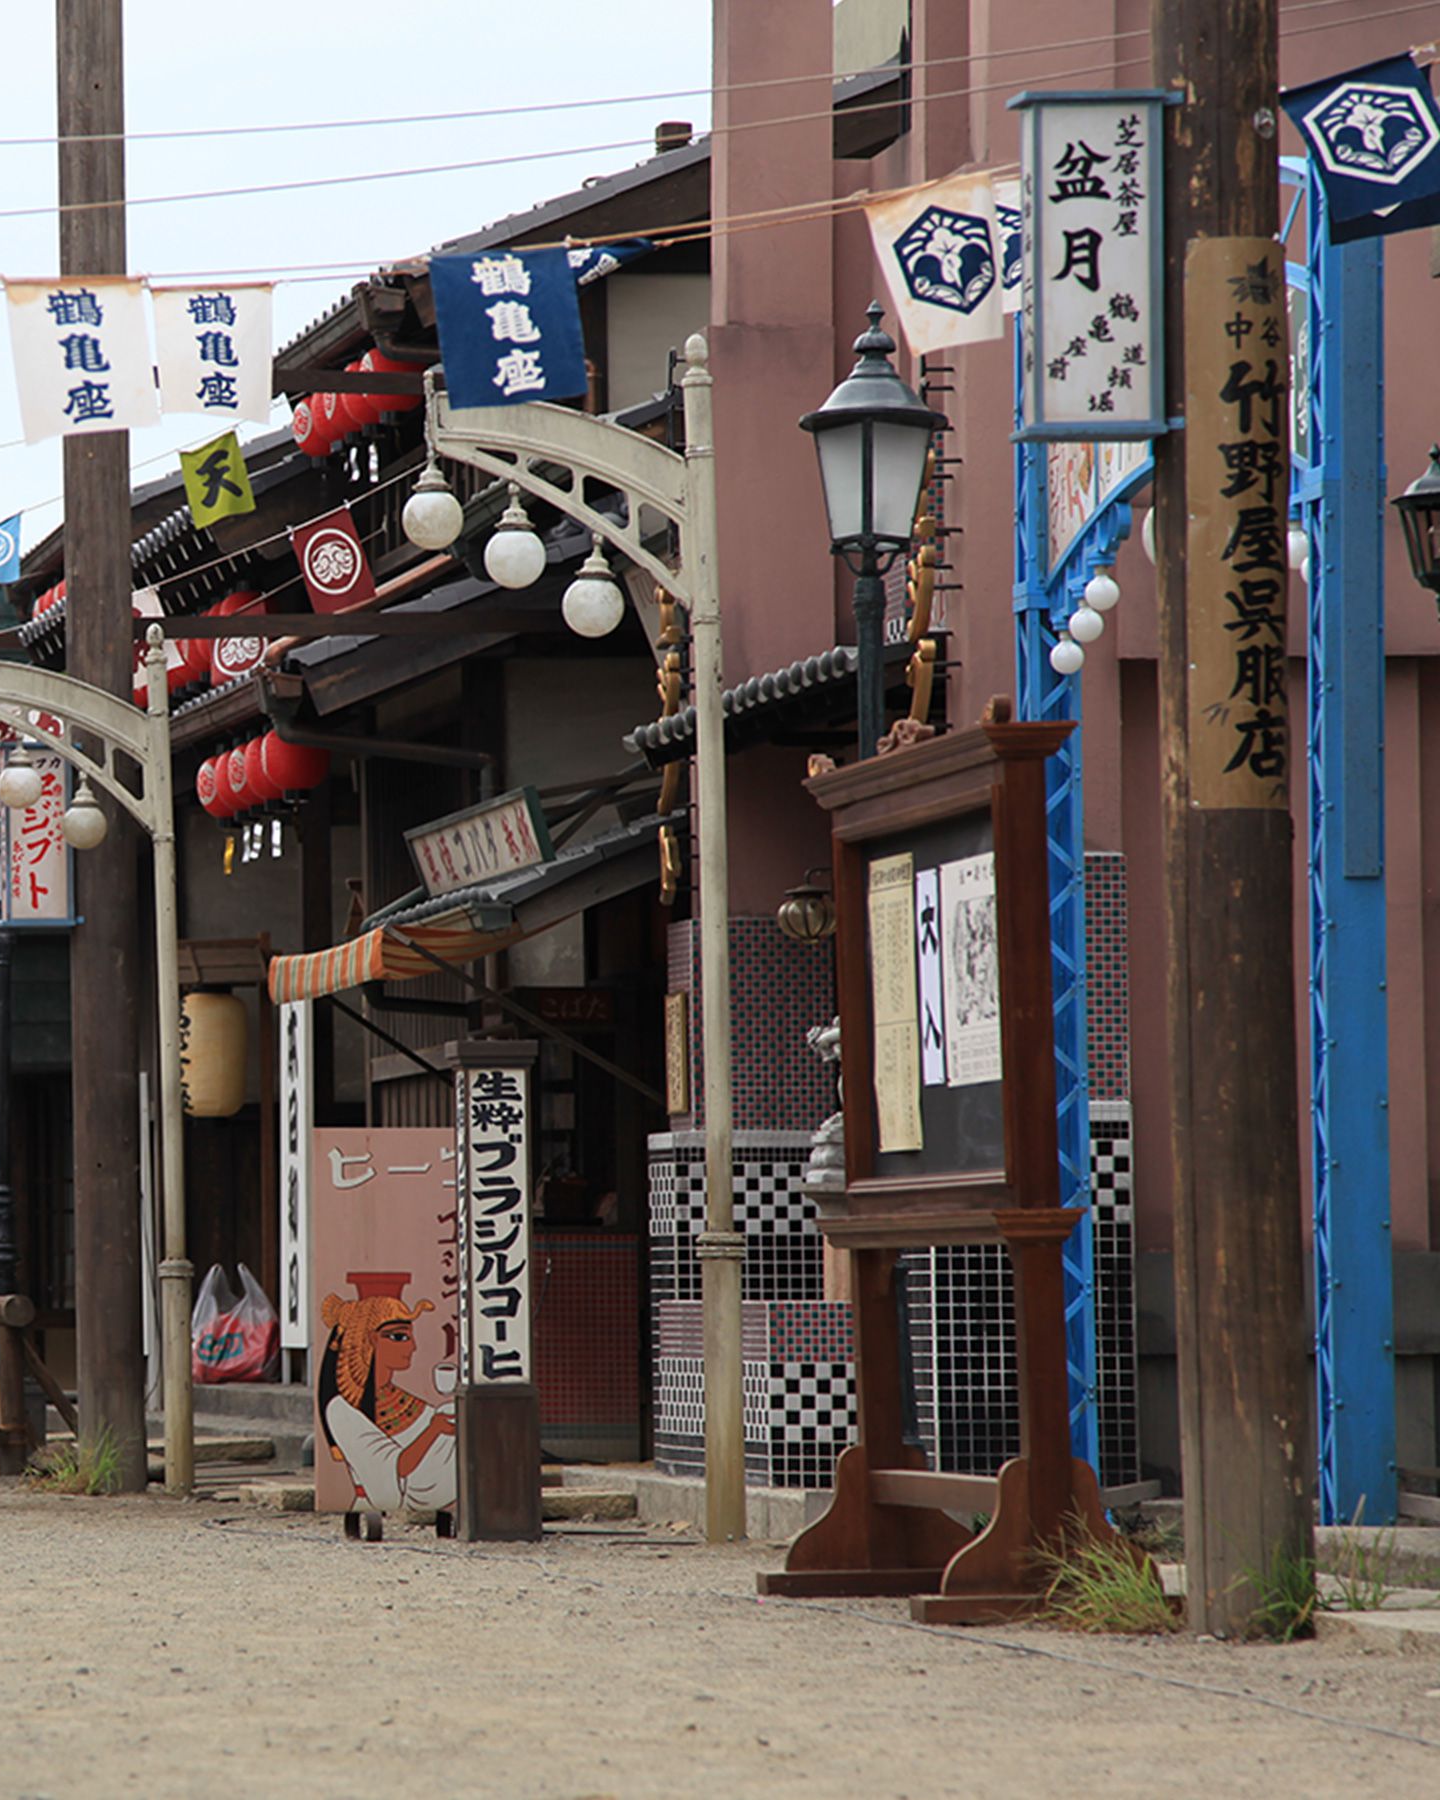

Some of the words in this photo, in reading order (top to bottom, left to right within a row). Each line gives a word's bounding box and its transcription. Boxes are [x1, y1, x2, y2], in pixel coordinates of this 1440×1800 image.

[1048, 139, 1111, 293] 盆月
[1112, 114, 1145, 236] 芝居茶屋
[46, 288, 113, 424] 鶴亀座
[187, 292, 239, 410] 鶴亀座
[472, 253, 547, 397] 鶴亀座
[195, 448, 243, 508] 天
[1219, 359, 1287, 778] 竹野屋呉服店
